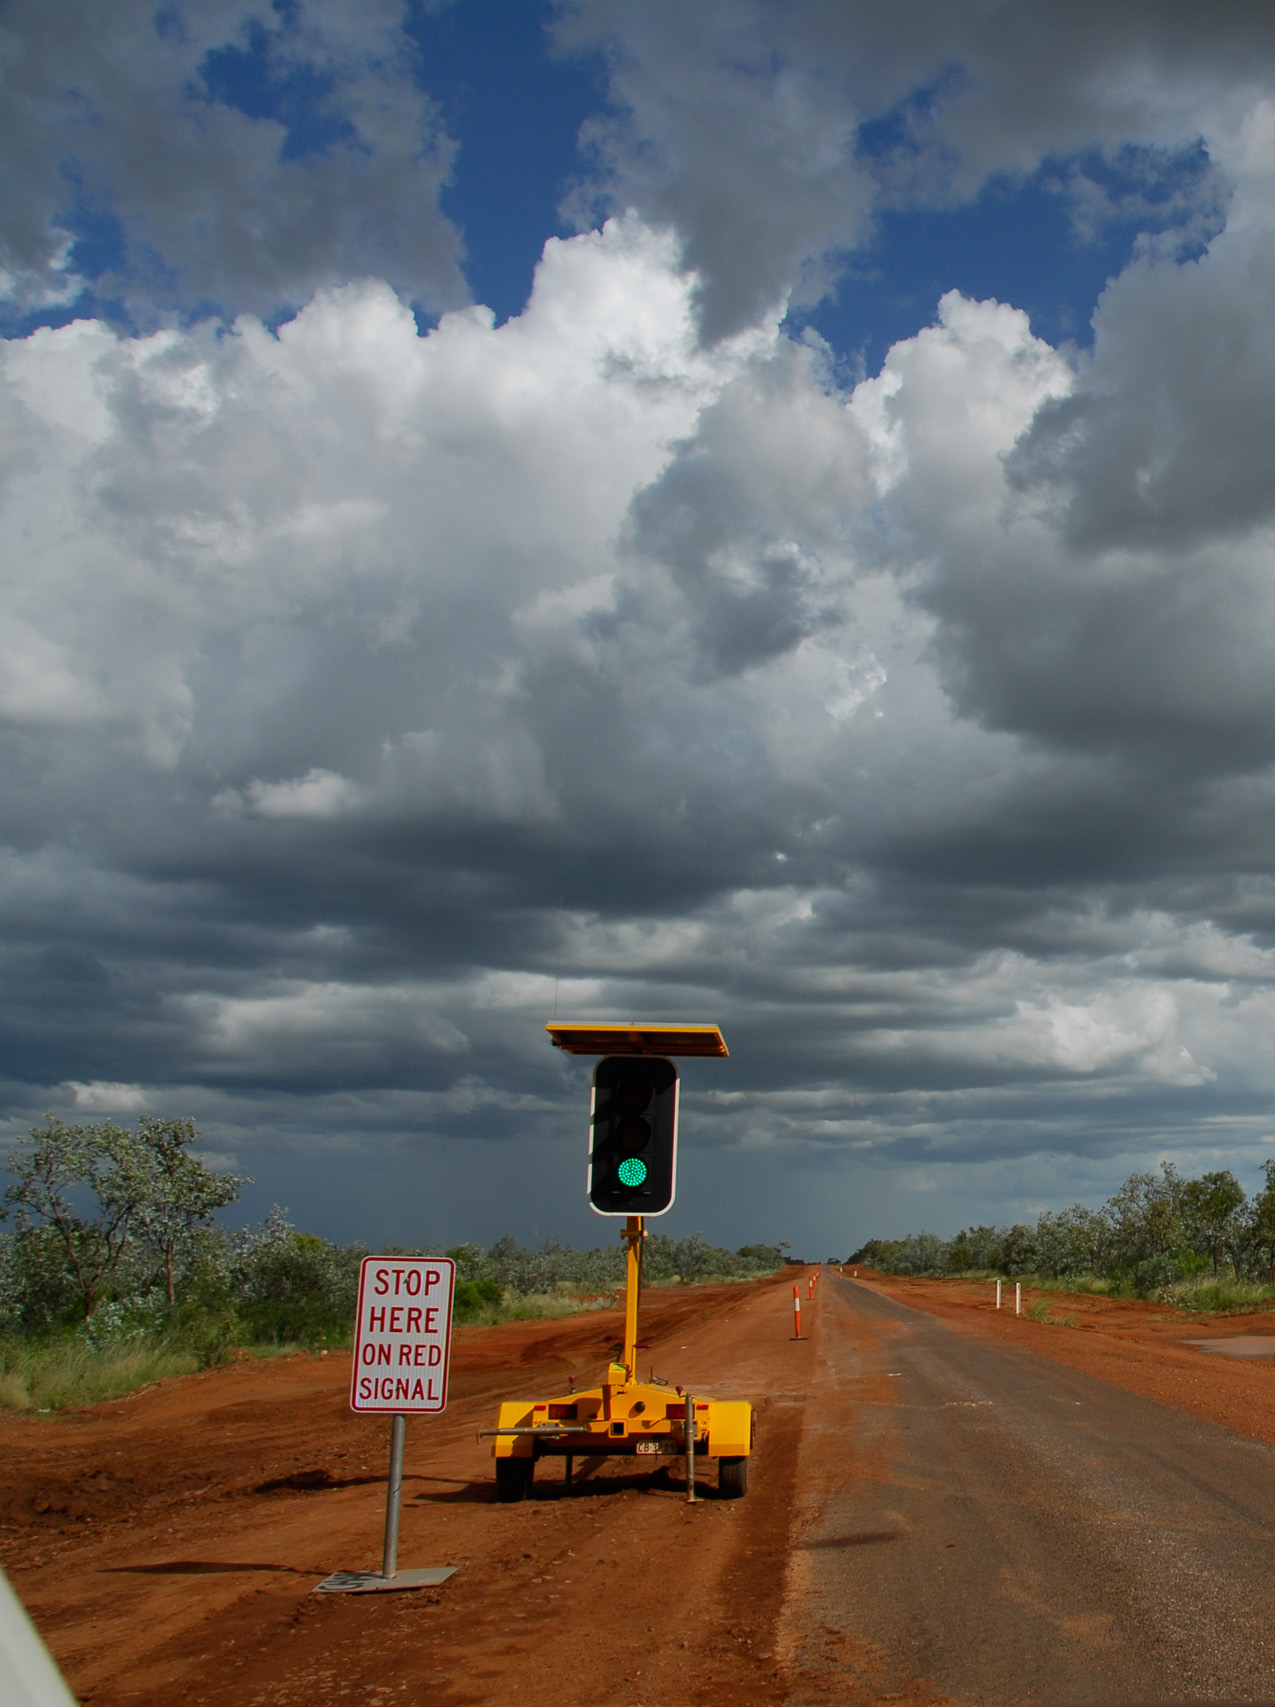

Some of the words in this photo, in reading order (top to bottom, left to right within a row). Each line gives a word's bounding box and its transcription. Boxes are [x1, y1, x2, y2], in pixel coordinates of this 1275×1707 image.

[374, 1269, 441, 1296] STOP
[369, 1306, 440, 1334] HERE
[362, 1343, 392, 1366] ON
[398, 1344, 442, 1367] RED
[359, 1377, 440, 1401] SIGNAL
